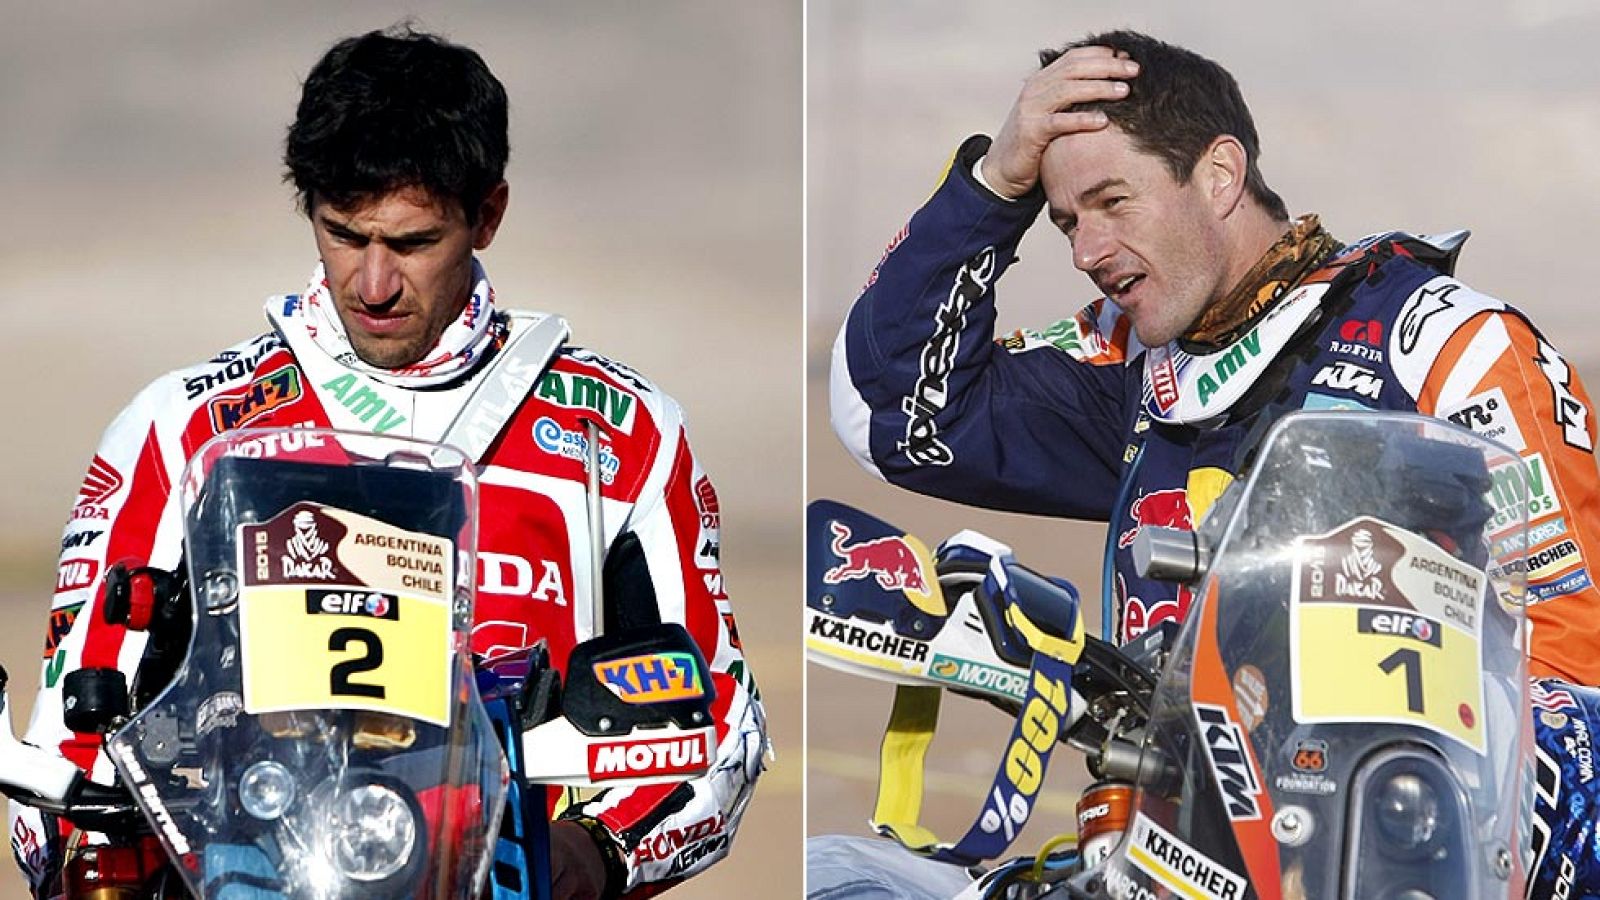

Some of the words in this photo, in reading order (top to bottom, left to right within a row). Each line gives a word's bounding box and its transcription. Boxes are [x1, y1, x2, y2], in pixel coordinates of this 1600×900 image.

[1329, 341, 1382, 363] ADRIA
[1153, 361, 1175, 404] TITE
[1311, 361, 1384, 399] KTM
[219, 371, 291, 430] KH-7
[354, 533, 443, 556] ARGENTINA
[281, 556, 336, 579] DAKAR
[387, 554, 443, 575] BOLIVIA
[1410, 556, 1478, 590] ARGENTINA
[402, 575, 442, 593] CHILE
[1335, 573, 1385, 600] DAKAR
[1434, 581, 1476, 608] BOLIVIA
[320, 593, 366, 613] elf
[1444, 604, 1475, 629] CHILE
[810, 616, 929, 662] KÄRCHER
[1372, 614, 1413, 634] elf
[328, 626, 386, 700] 2
[603, 657, 693, 697] KH-7
[1378, 647, 1424, 714] 1
[593, 739, 705, 773] MOTUL
[980, 670, 1068, 842] 100%
[1145, 829, 1239, 900] KÄRCHER
